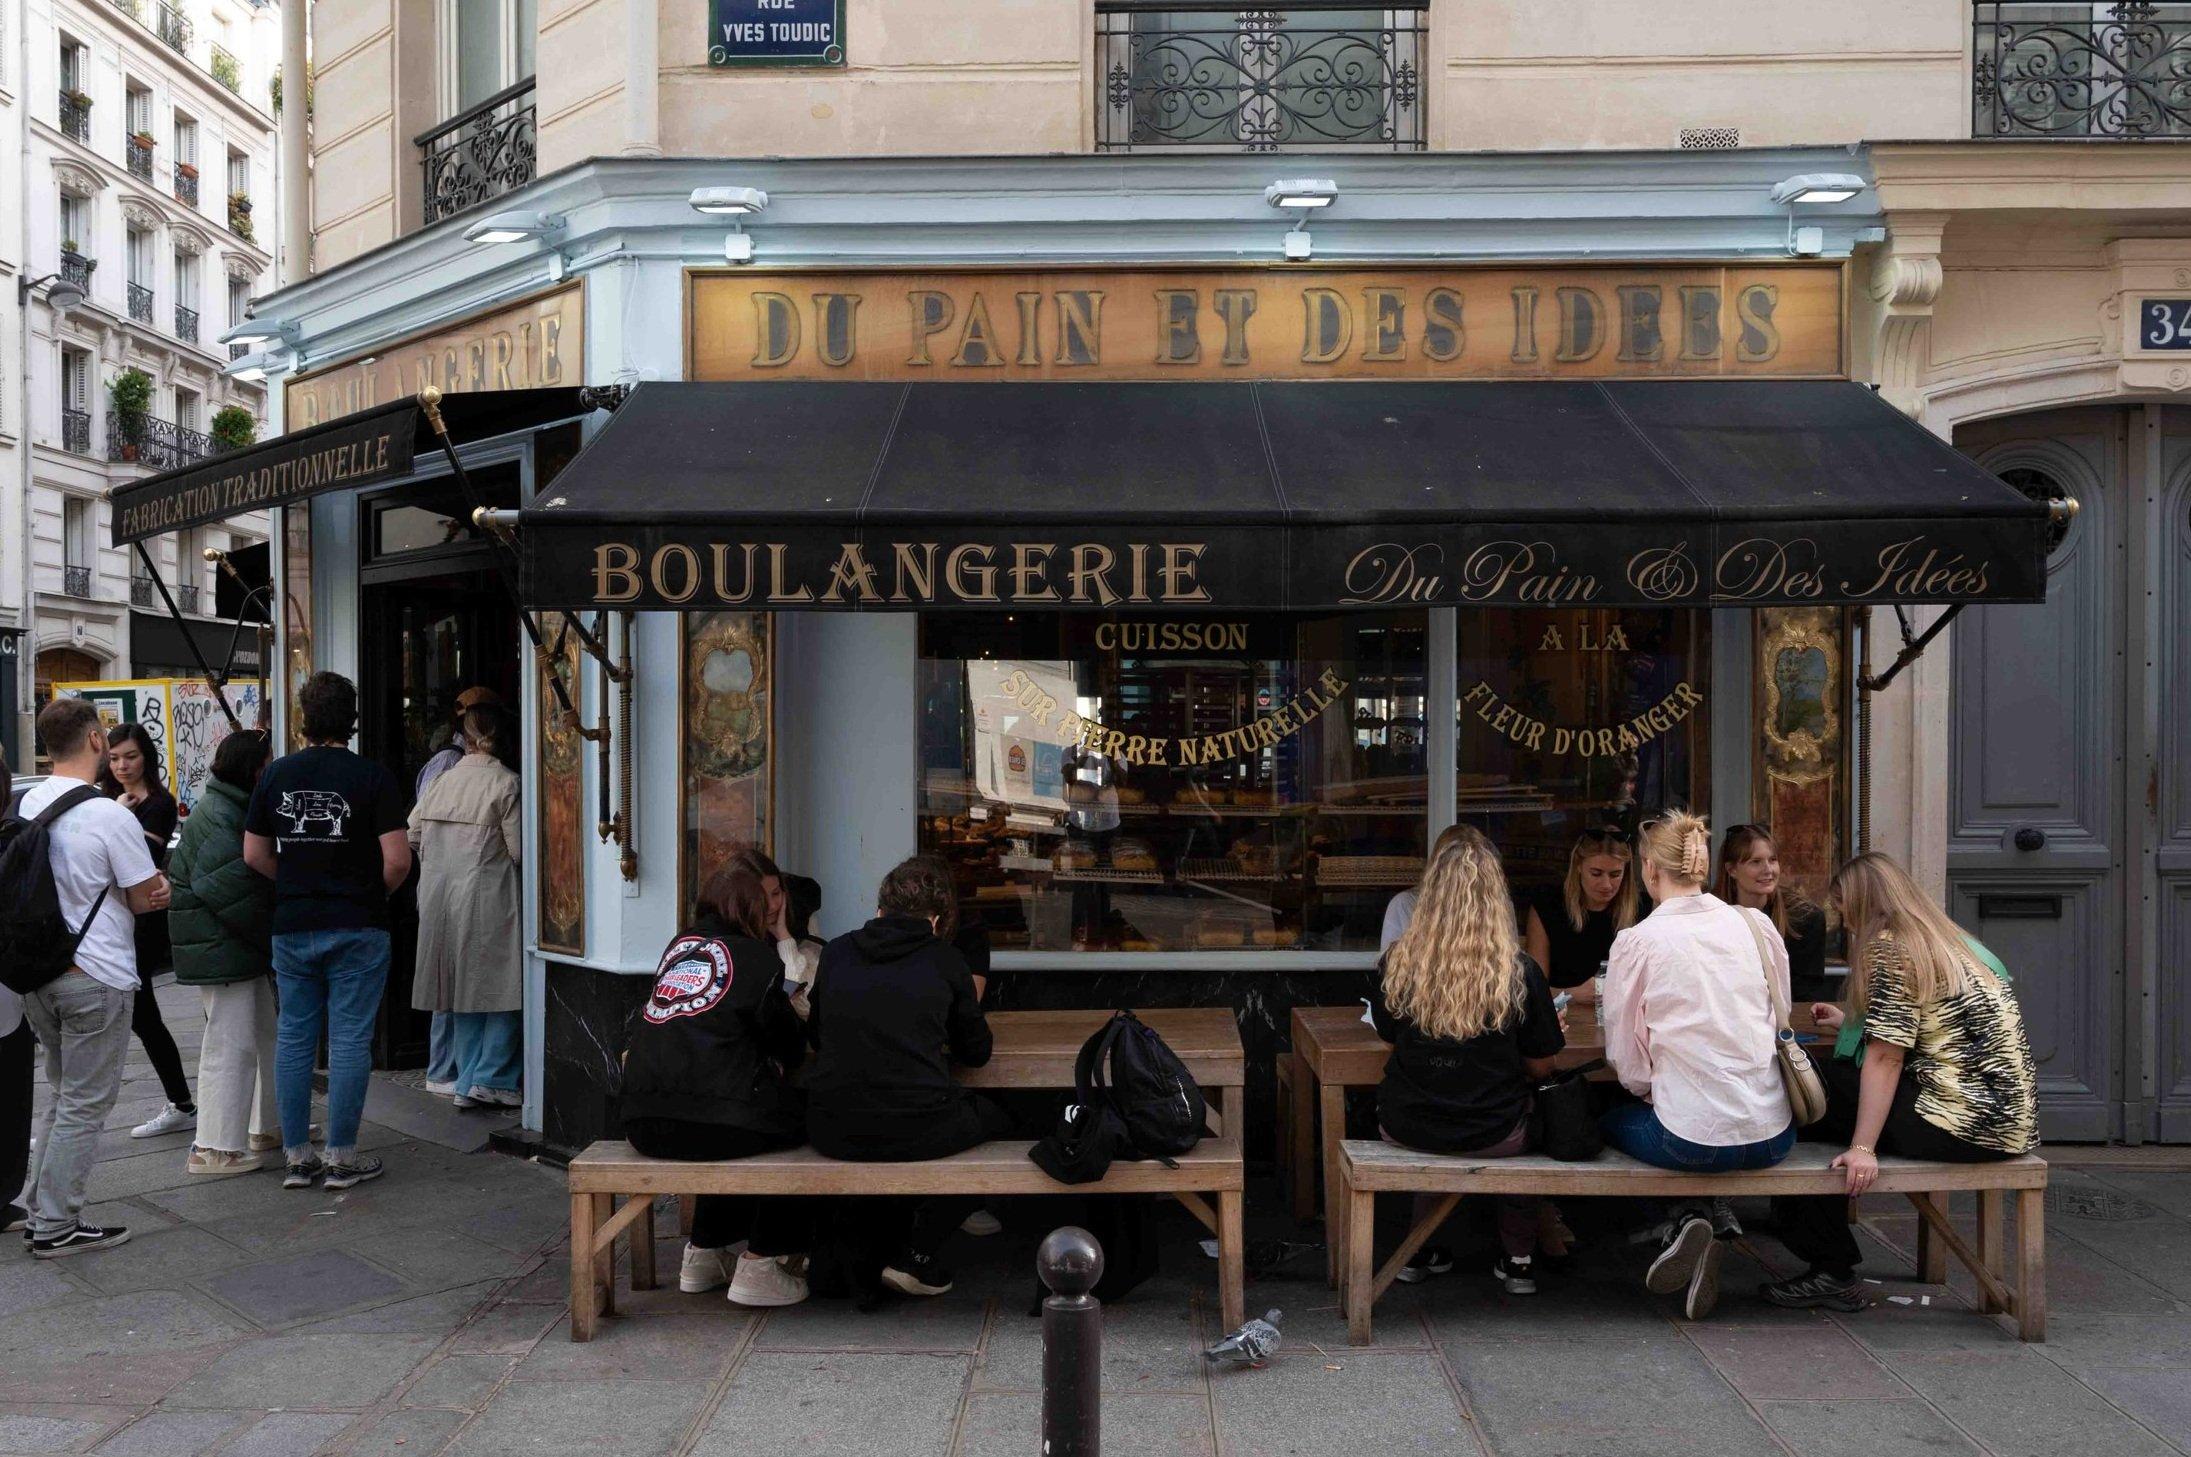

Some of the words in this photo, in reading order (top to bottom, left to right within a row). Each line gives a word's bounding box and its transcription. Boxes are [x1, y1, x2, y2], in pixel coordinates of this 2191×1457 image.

[722, 23, 765, 42] YVES
[770, 23, 831, 42] TOUDIC
[750, 290, 862, 367] DU
[906, 290, 1105, 367] PAIN
[1154, 288, 1258, 366] ET
[1300, 286, 1467, 365] DES
[1510, 284, 1781, 363] IDEES
[122, 481, 219, 538] FABRICATION
[223, 434, 391, 509] TRADITIONNELLE
[590, 543, 1212, 608] BOULANGERIE
[1338, 541, 1444, 604] Du
[1460, 540, 1602, 601] Pain
[1626, 540, 1699, 600] &
[1708, 538, 1824, 600] Des
[1840, 535, 1989, 598] Idées
[1095, 623, 1250, 651] CUISSON
[1537, 624, 1565, 650] A
[1579, 624, 1630, 650] LA
[1000, 670, 1057, 726] SUR
[1056, 709, 1168, 766] PIERRE
[1178, 665, 1350, 766] NATURELLE
[1464, 680, 1546, 751] FLEUR
[1552, 682, 1704, 757] D'ORANGER
